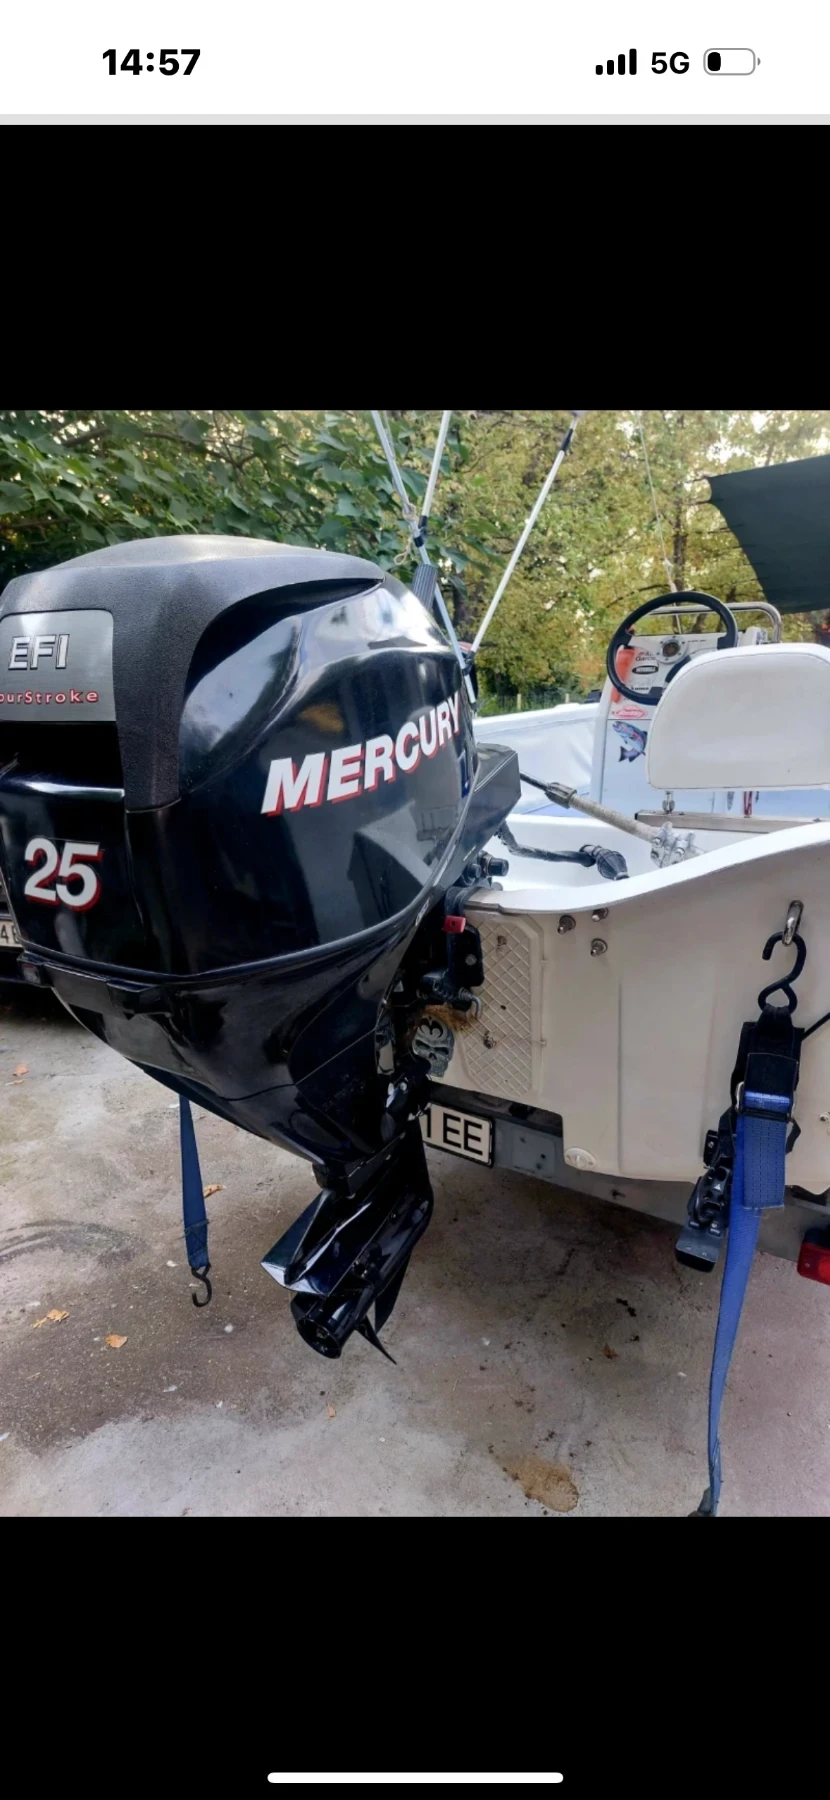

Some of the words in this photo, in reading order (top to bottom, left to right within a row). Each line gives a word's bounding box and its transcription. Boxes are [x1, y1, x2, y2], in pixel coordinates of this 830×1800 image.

[8, 634, 70, 671] EFI
[261, 692, 461, 818] MERCURY
[24, 837, 103, 912] 25
[443, 1112, 483, 1155] EE
